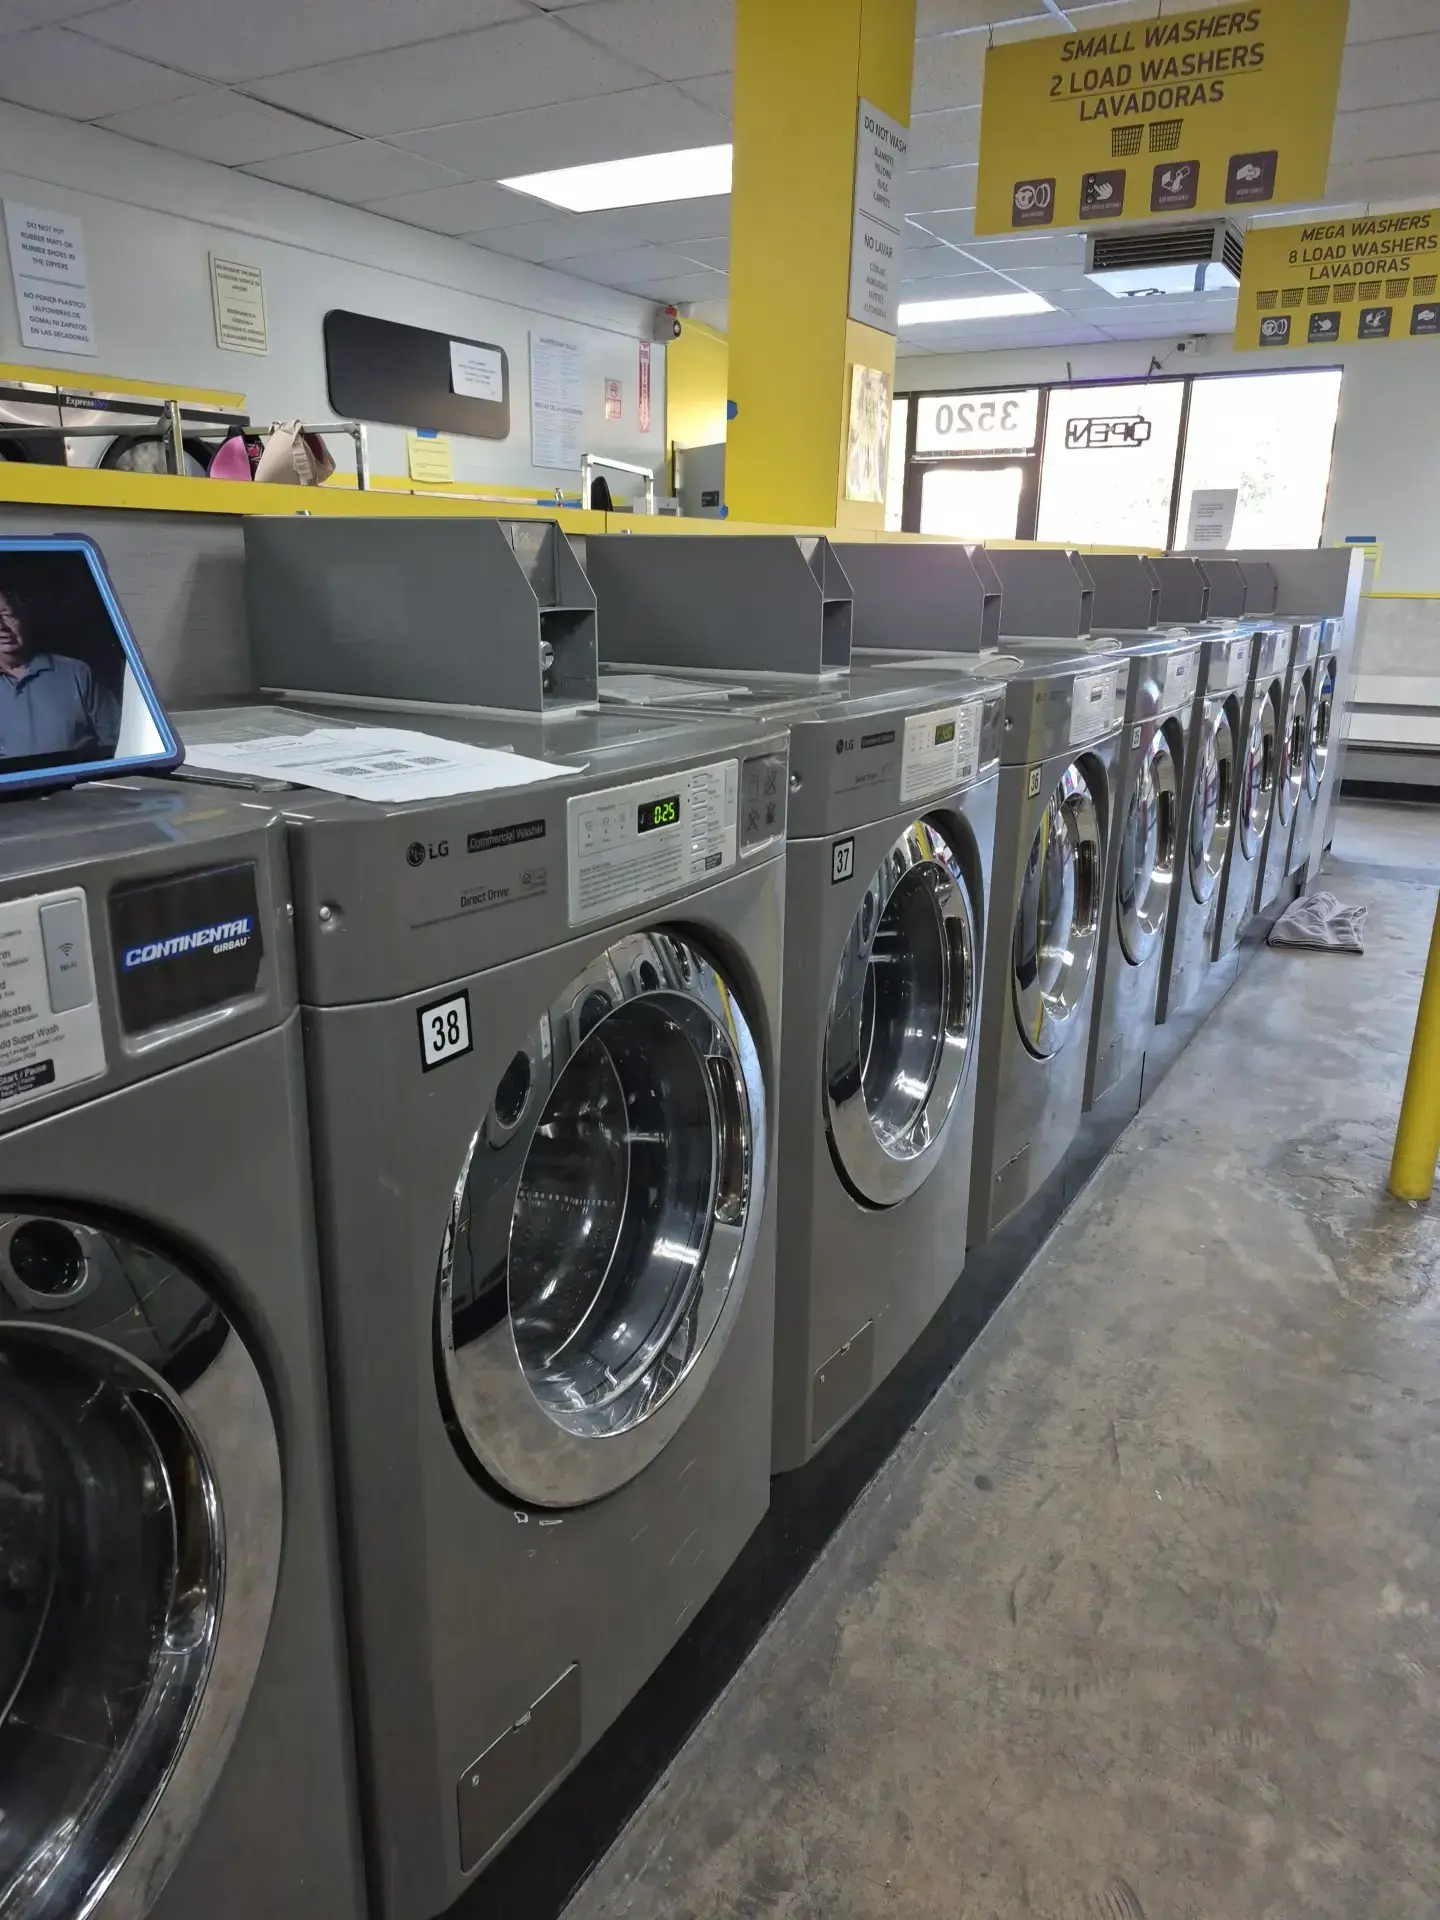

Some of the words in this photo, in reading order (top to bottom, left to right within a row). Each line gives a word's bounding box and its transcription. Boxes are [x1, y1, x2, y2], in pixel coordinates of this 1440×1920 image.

[1061, 30, 1135, 62] SMALL
[1144, 9, 1262, 48] WASHERS
[1050, 75, 1062, 96] 2
[1070, 63, 1131, 94] LOAD
[1140, 43, 1265, 82] WASHERS
[1079, 80, 1224, 121] LAVADORAS
[864, 116, 875, 133] DO
[876, 123, 889, 143] NOT
[889, 132, 907, 154] WASH
[877, 178, 888, 192] RUGS
[21, 231, 45, 243] RUBBER
[46, 236, 62, 246] MATS
[27, 221, 37, 229] DO
[38, 224, 52, 232] NOT
[53, 227, 64, 235] PUT
[1301, 224, 1345, 242] MEGA
[1351, 215, 1431, 237] WASHERS
[22, 243, 45, 254] RUBBER
[48, 248, 67, 259] SHOES
[864, 233, 874, 250] NO
[875, 239, 893, 259] LAVAR
[1288, 250, 1297, 263] 8
[1302, 245, 1346, 263] LOAD
[1352, 235, 1438, 257] WASHERS
[32, 257, 44, 266] THE
[46, 258, 68, 271] DRYERS
[1309, 257, 1410, 280] LAVADORAS
[36, 293, 57, 304] PONER
[30, 327, 39, 335] EN
[40, 328, 52, 337] LAS
[60, 320, 87, 331] ZAPATOS
[1031, 772, 1039, 791] 36
[470, 830, 515, 849] Commercial
[516, 824, 544, 839] Washer
[428, 840, 449, 859] LG
[837, 847, 849, 874] 37
[460, 892, 486, 907] Direct
[487, 887, 510, 901] Drive
[125, 918, 250, 967] CONTINENTAL
[213, 936, 247, 954] GIRBAU
[12, 1032, 36, 1046] Super
[36, 1024, 59, 1038] Wash
[432, 1009, 460, 1052] 38
[24, 1063, 48, 1078] Pause
